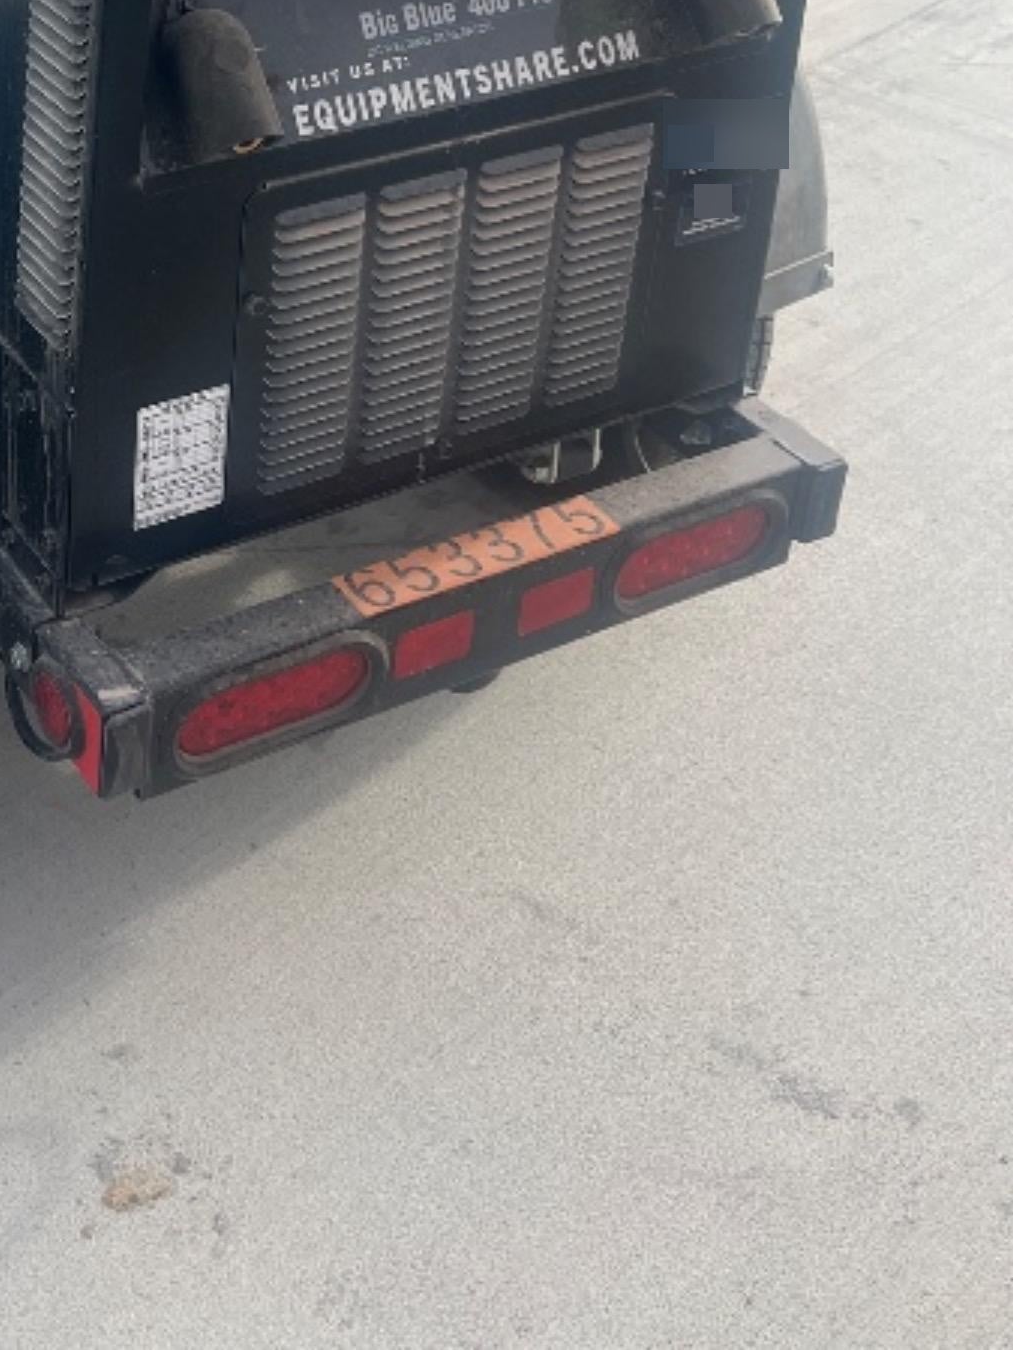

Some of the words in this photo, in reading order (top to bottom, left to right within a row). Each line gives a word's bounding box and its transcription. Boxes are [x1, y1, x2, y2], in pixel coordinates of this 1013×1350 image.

[287, 68, 340, 94] VISIT
[349, 63, 374, 79] US
[382, 55, 410, 74] AT:
[293, 29, 639, 137] EQUIPMENTSHARE.COM
[344, 505, 605, 606] 653375
